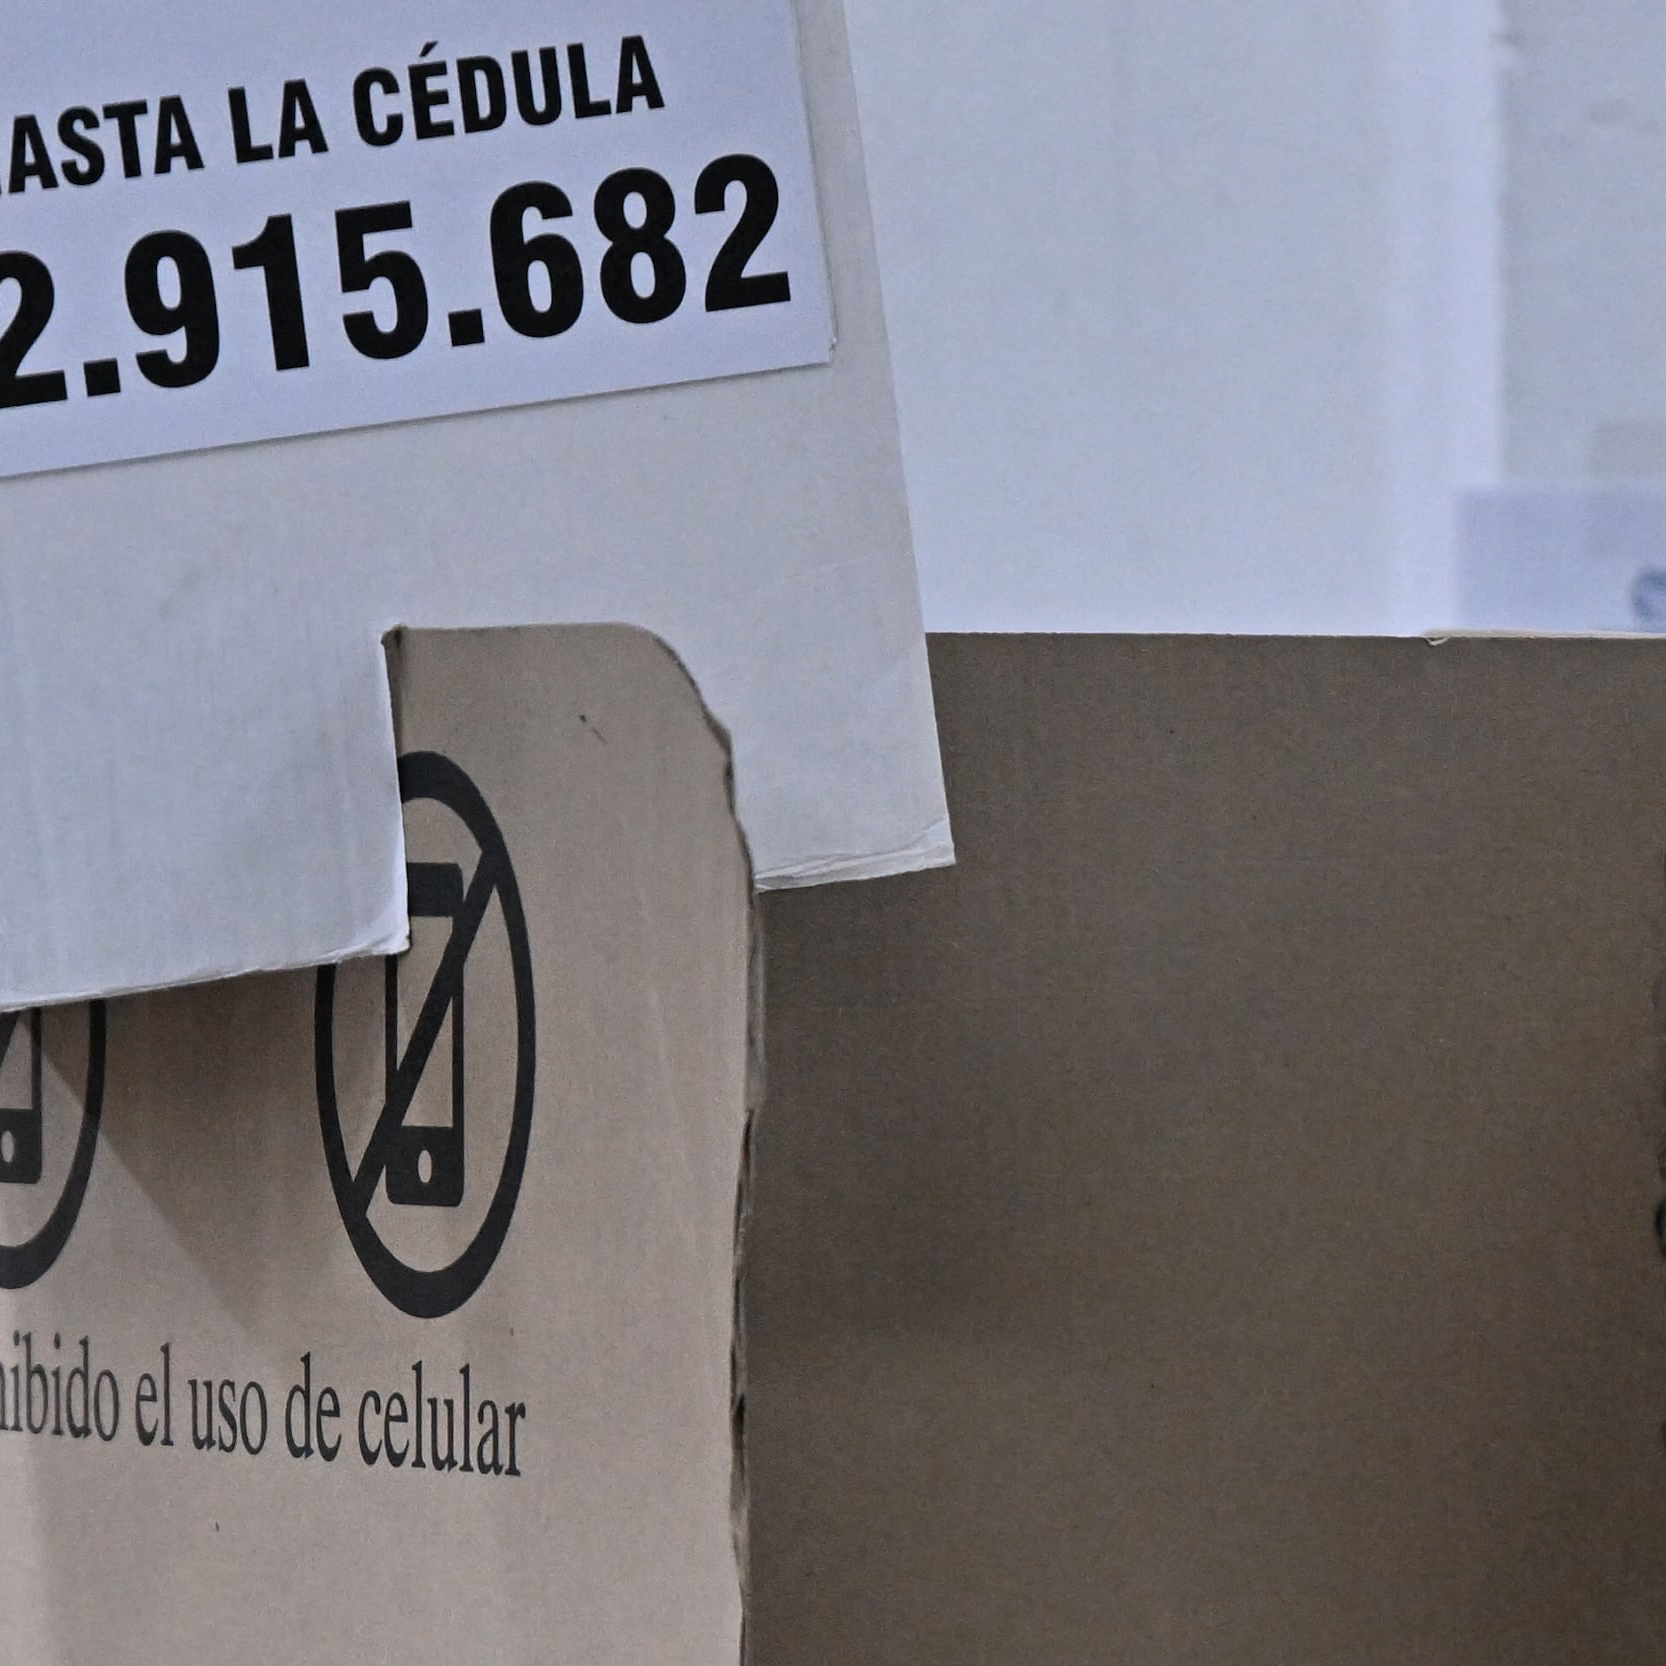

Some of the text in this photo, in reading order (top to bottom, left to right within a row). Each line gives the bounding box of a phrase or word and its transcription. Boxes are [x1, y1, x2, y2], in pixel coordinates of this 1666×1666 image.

[229, 78, 330, 165] LA
[353, 35, 666, 149] CÉDULA
[134, 1342, 175, 1448] el
[187, 1377, 269, 1457] uso
[284, 1351, 343, 1463] de
[357, 1359, 527, 1478] celular
